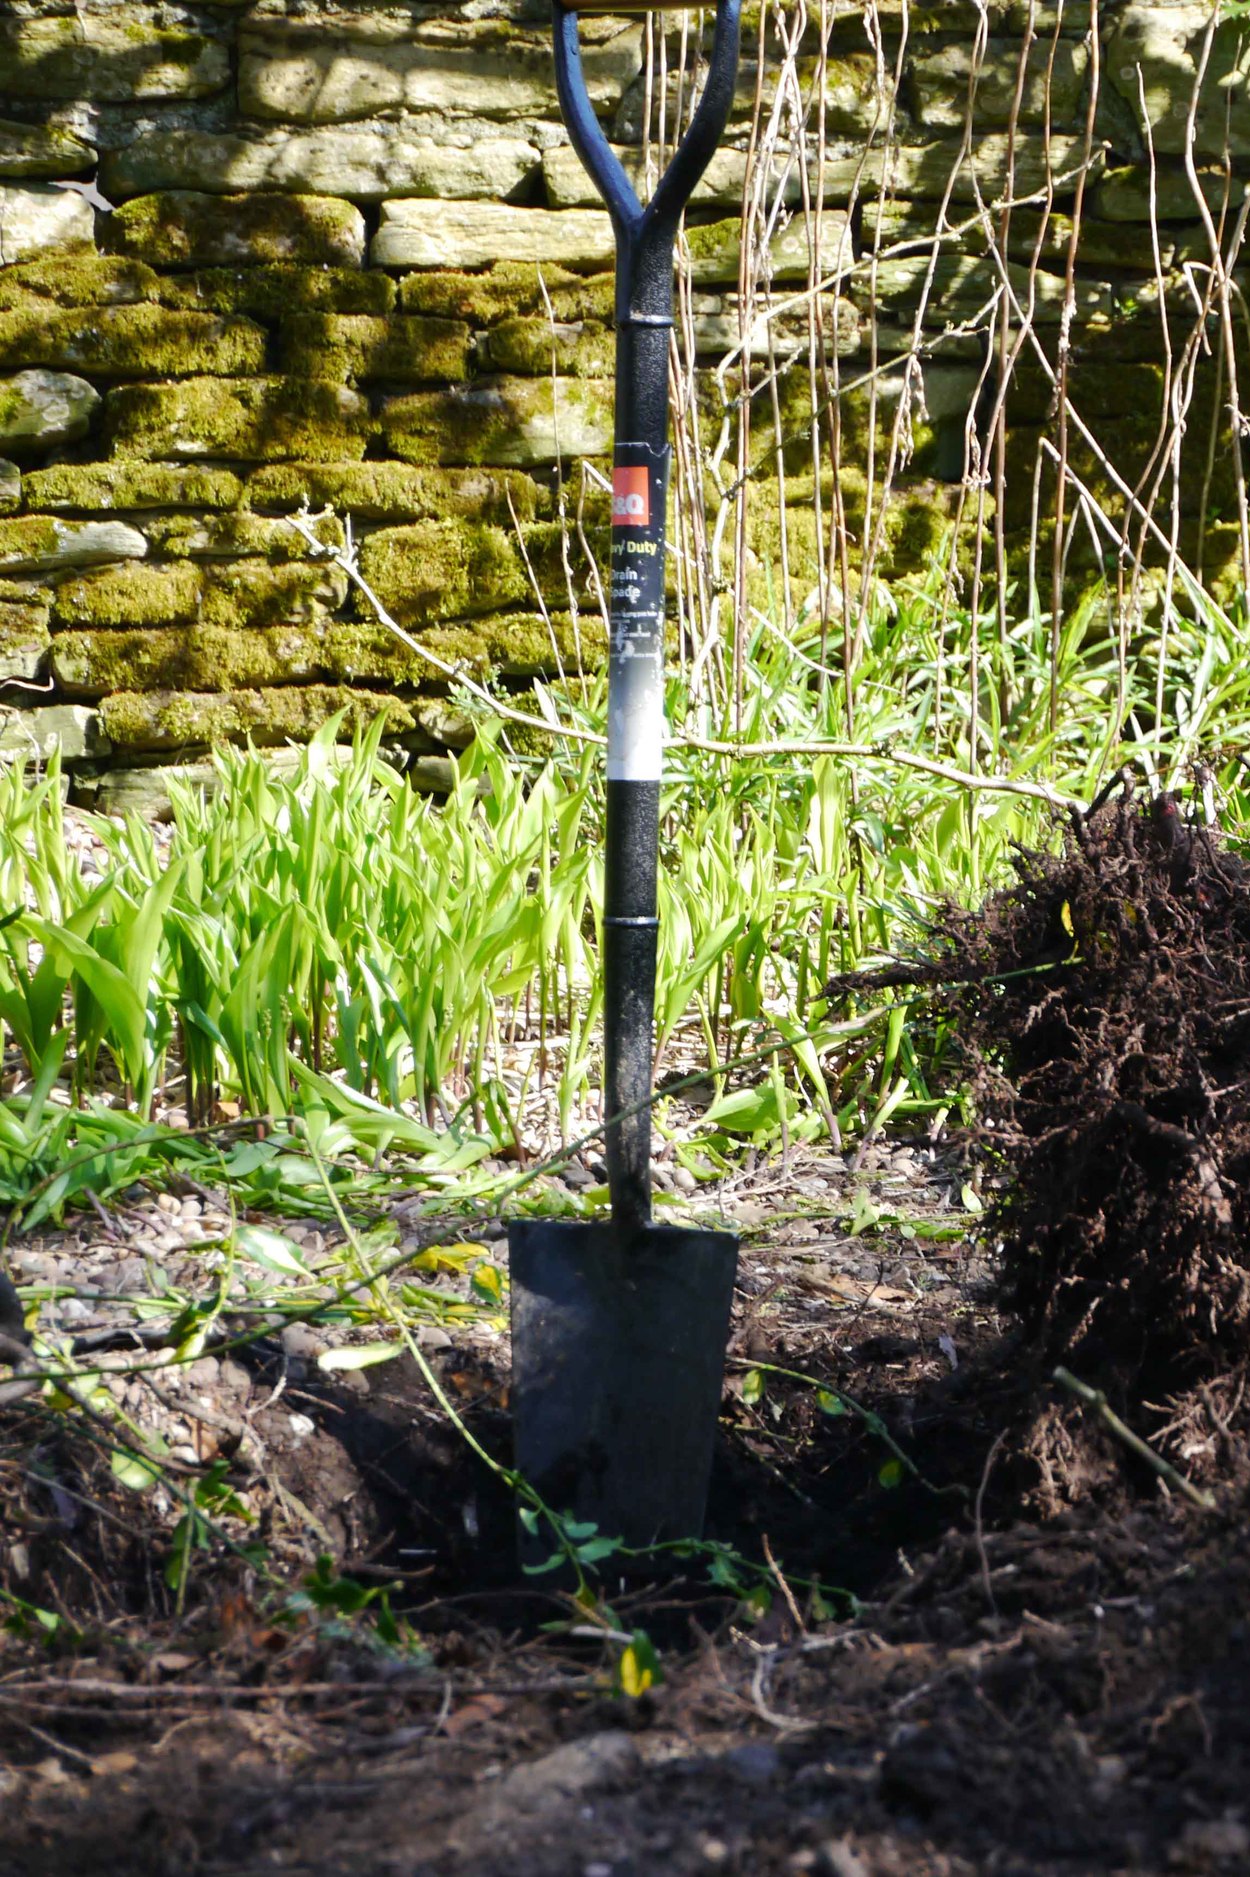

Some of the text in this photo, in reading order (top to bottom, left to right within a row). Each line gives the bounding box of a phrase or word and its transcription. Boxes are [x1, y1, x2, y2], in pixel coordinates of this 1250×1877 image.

[612, 493, 645, 515] &Q
[626, 540, 658, 556] Duty
[610, 585, 641, 598] pade
